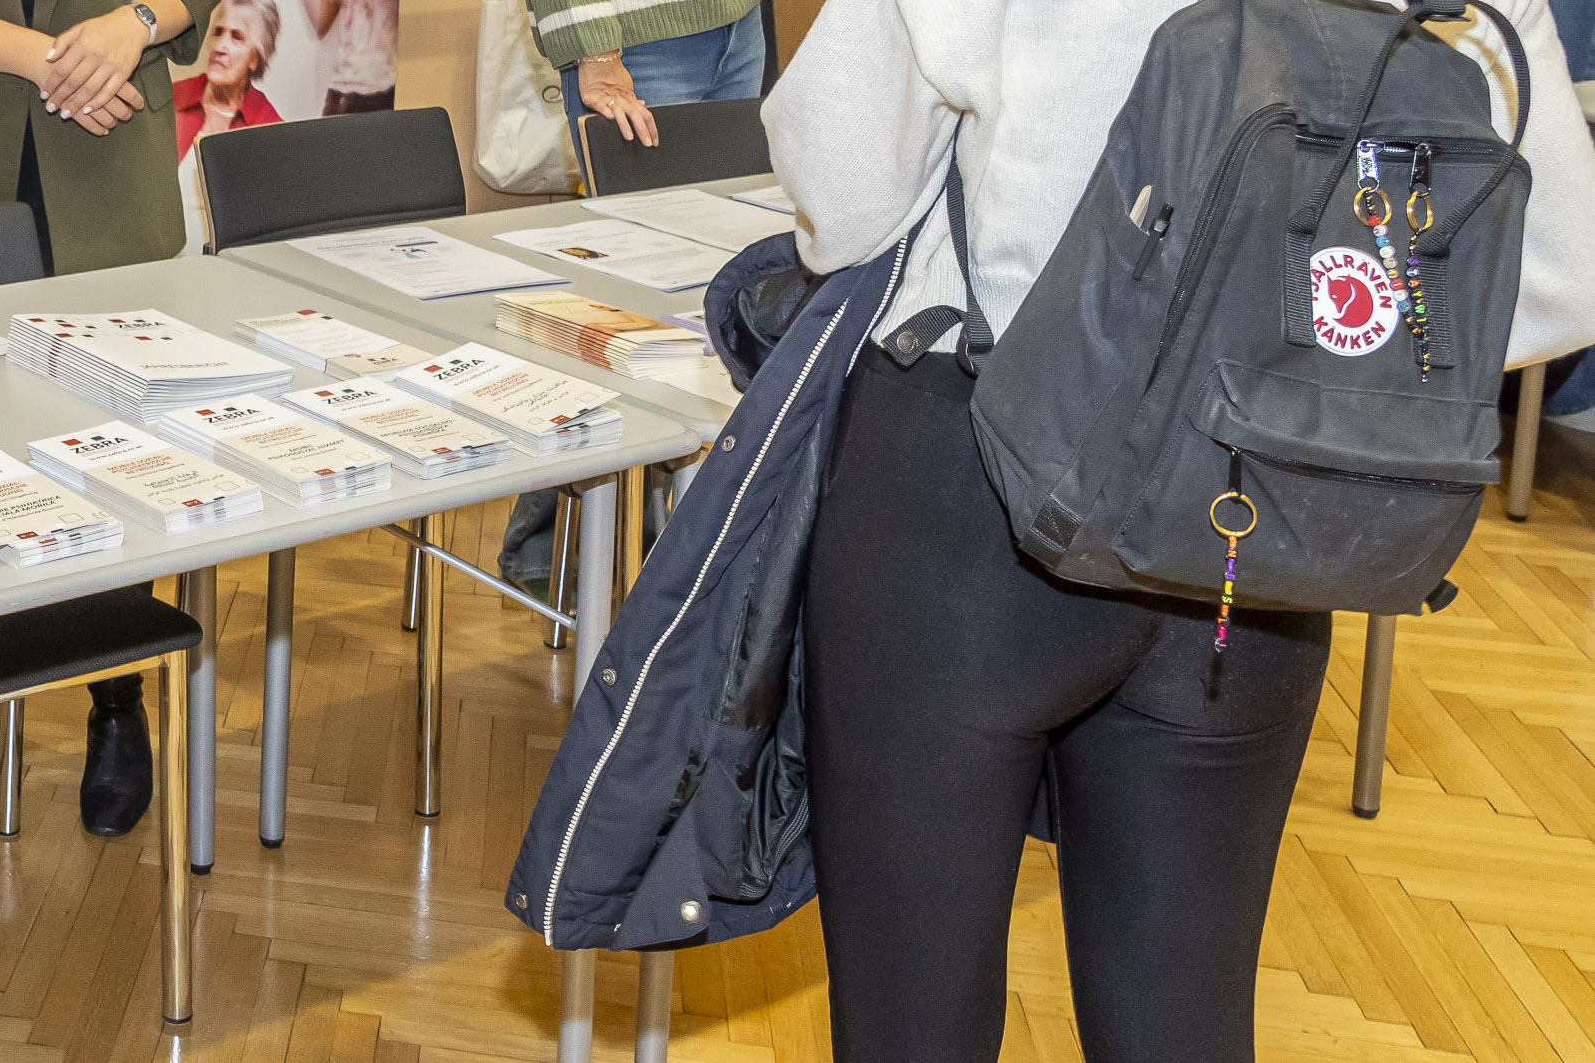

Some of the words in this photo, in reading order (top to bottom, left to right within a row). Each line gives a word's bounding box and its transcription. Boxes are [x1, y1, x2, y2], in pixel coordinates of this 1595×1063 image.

[1310, 254, 1393, 309] JÄLLRÄVEN
[1313, 315, 1386, 350] KÅNKEN
[433, 358, 485, 381] ZEBRA
[322, 390, 377, 405] ZEBRA
[203, 409, 261, 424] ZEBRA
[69, 436, 129, 455] ZEBRA
